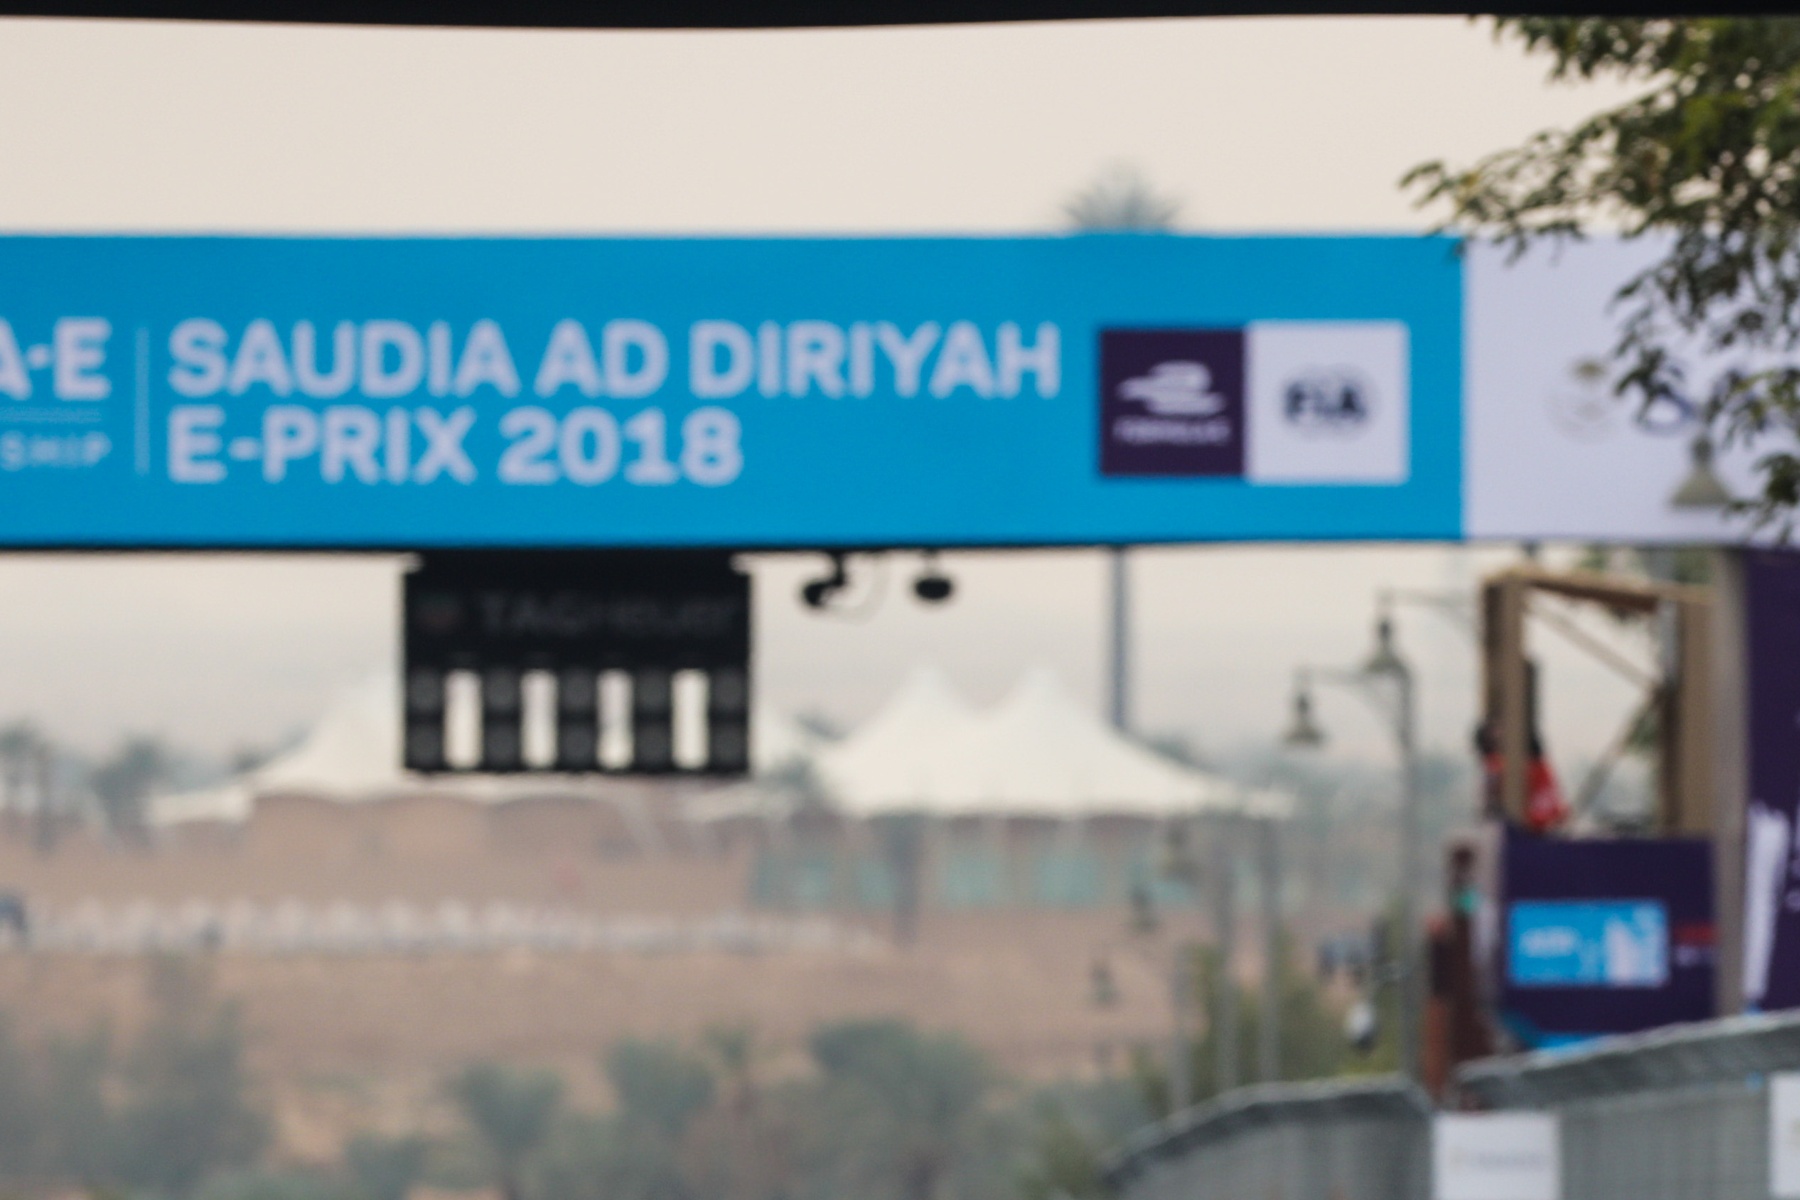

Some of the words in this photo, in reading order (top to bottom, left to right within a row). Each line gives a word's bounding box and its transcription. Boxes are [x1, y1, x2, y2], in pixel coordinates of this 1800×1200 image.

[168, 317, 521, 399] SAUDIA
[533, 317, 670, 399] AD
[688, 318, 1062, 400] DIRIYAH
[167, 404, 479, 486] E-PRIX
[496, 405, 745, 488] 2018
